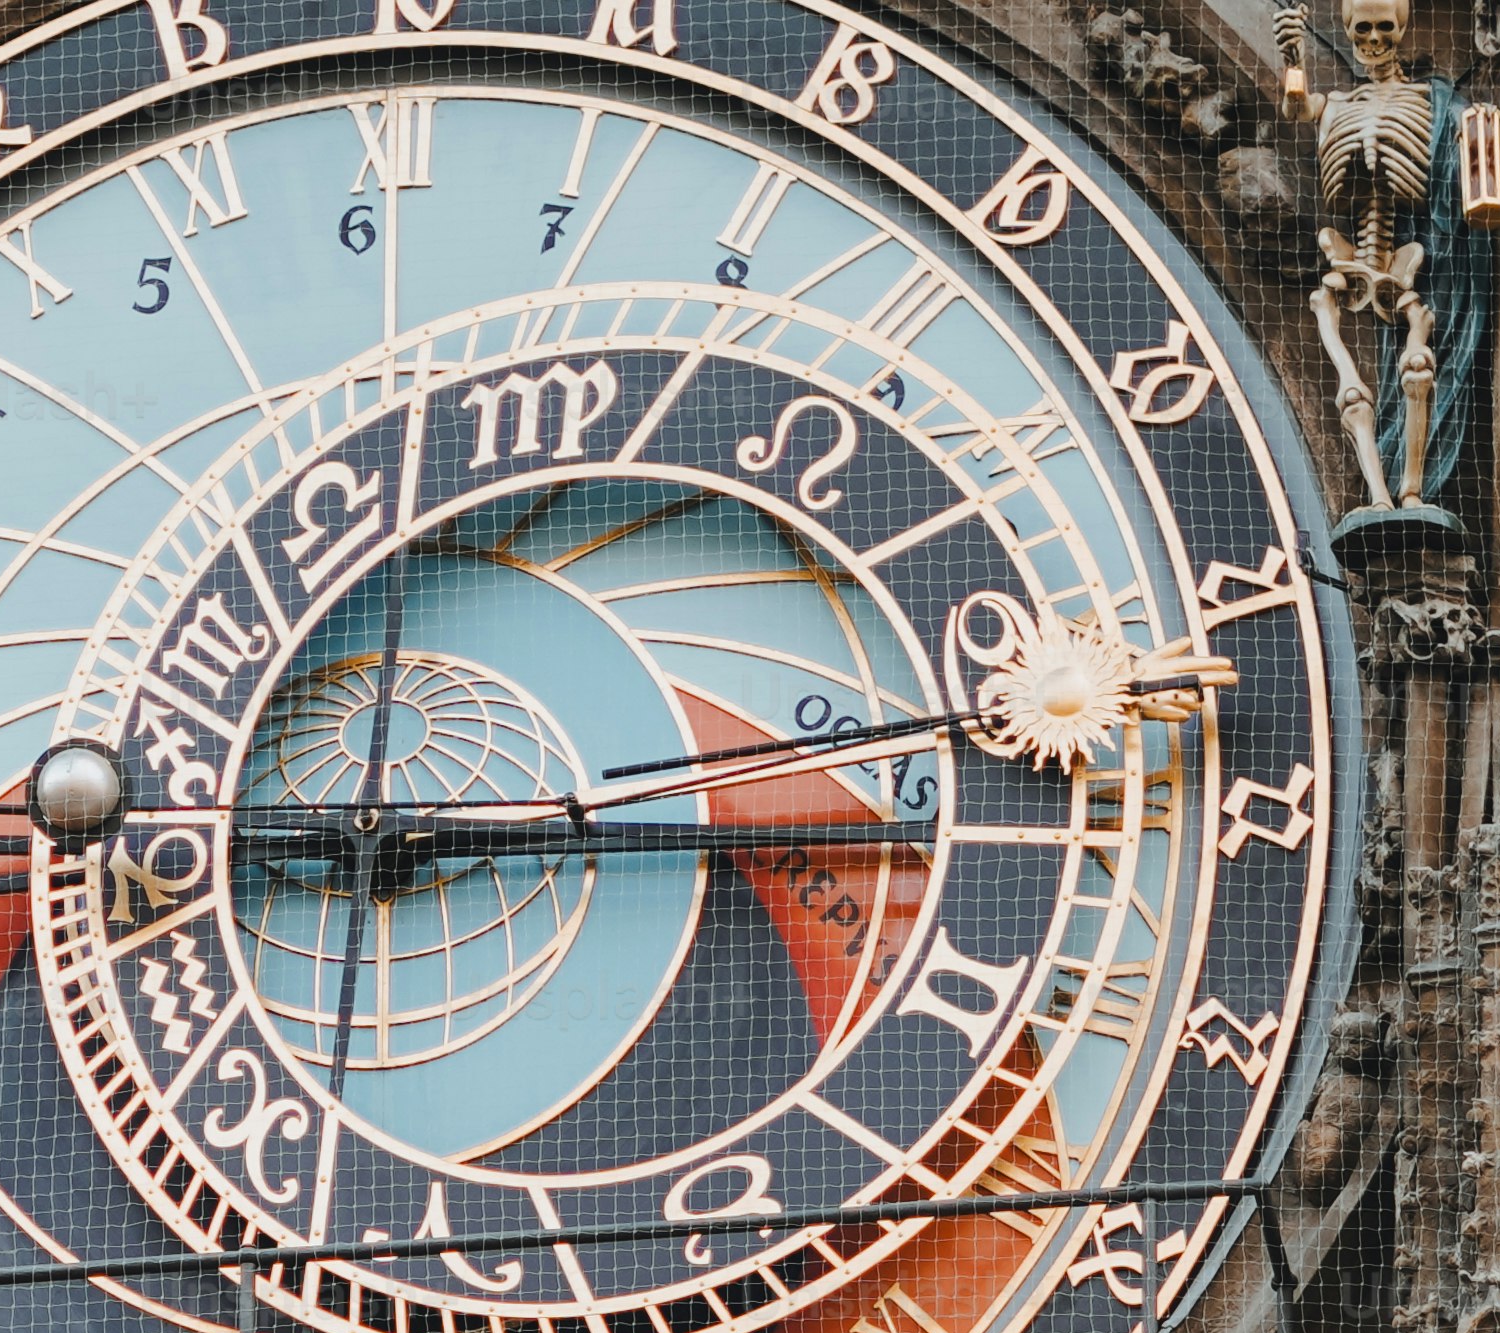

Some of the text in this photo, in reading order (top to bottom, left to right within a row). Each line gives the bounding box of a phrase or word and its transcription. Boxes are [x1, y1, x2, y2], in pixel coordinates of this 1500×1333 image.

[337, 206, 375, 255] 6
[539, 203, 574, 253] 7
[132, 257, 172, 314] 5
